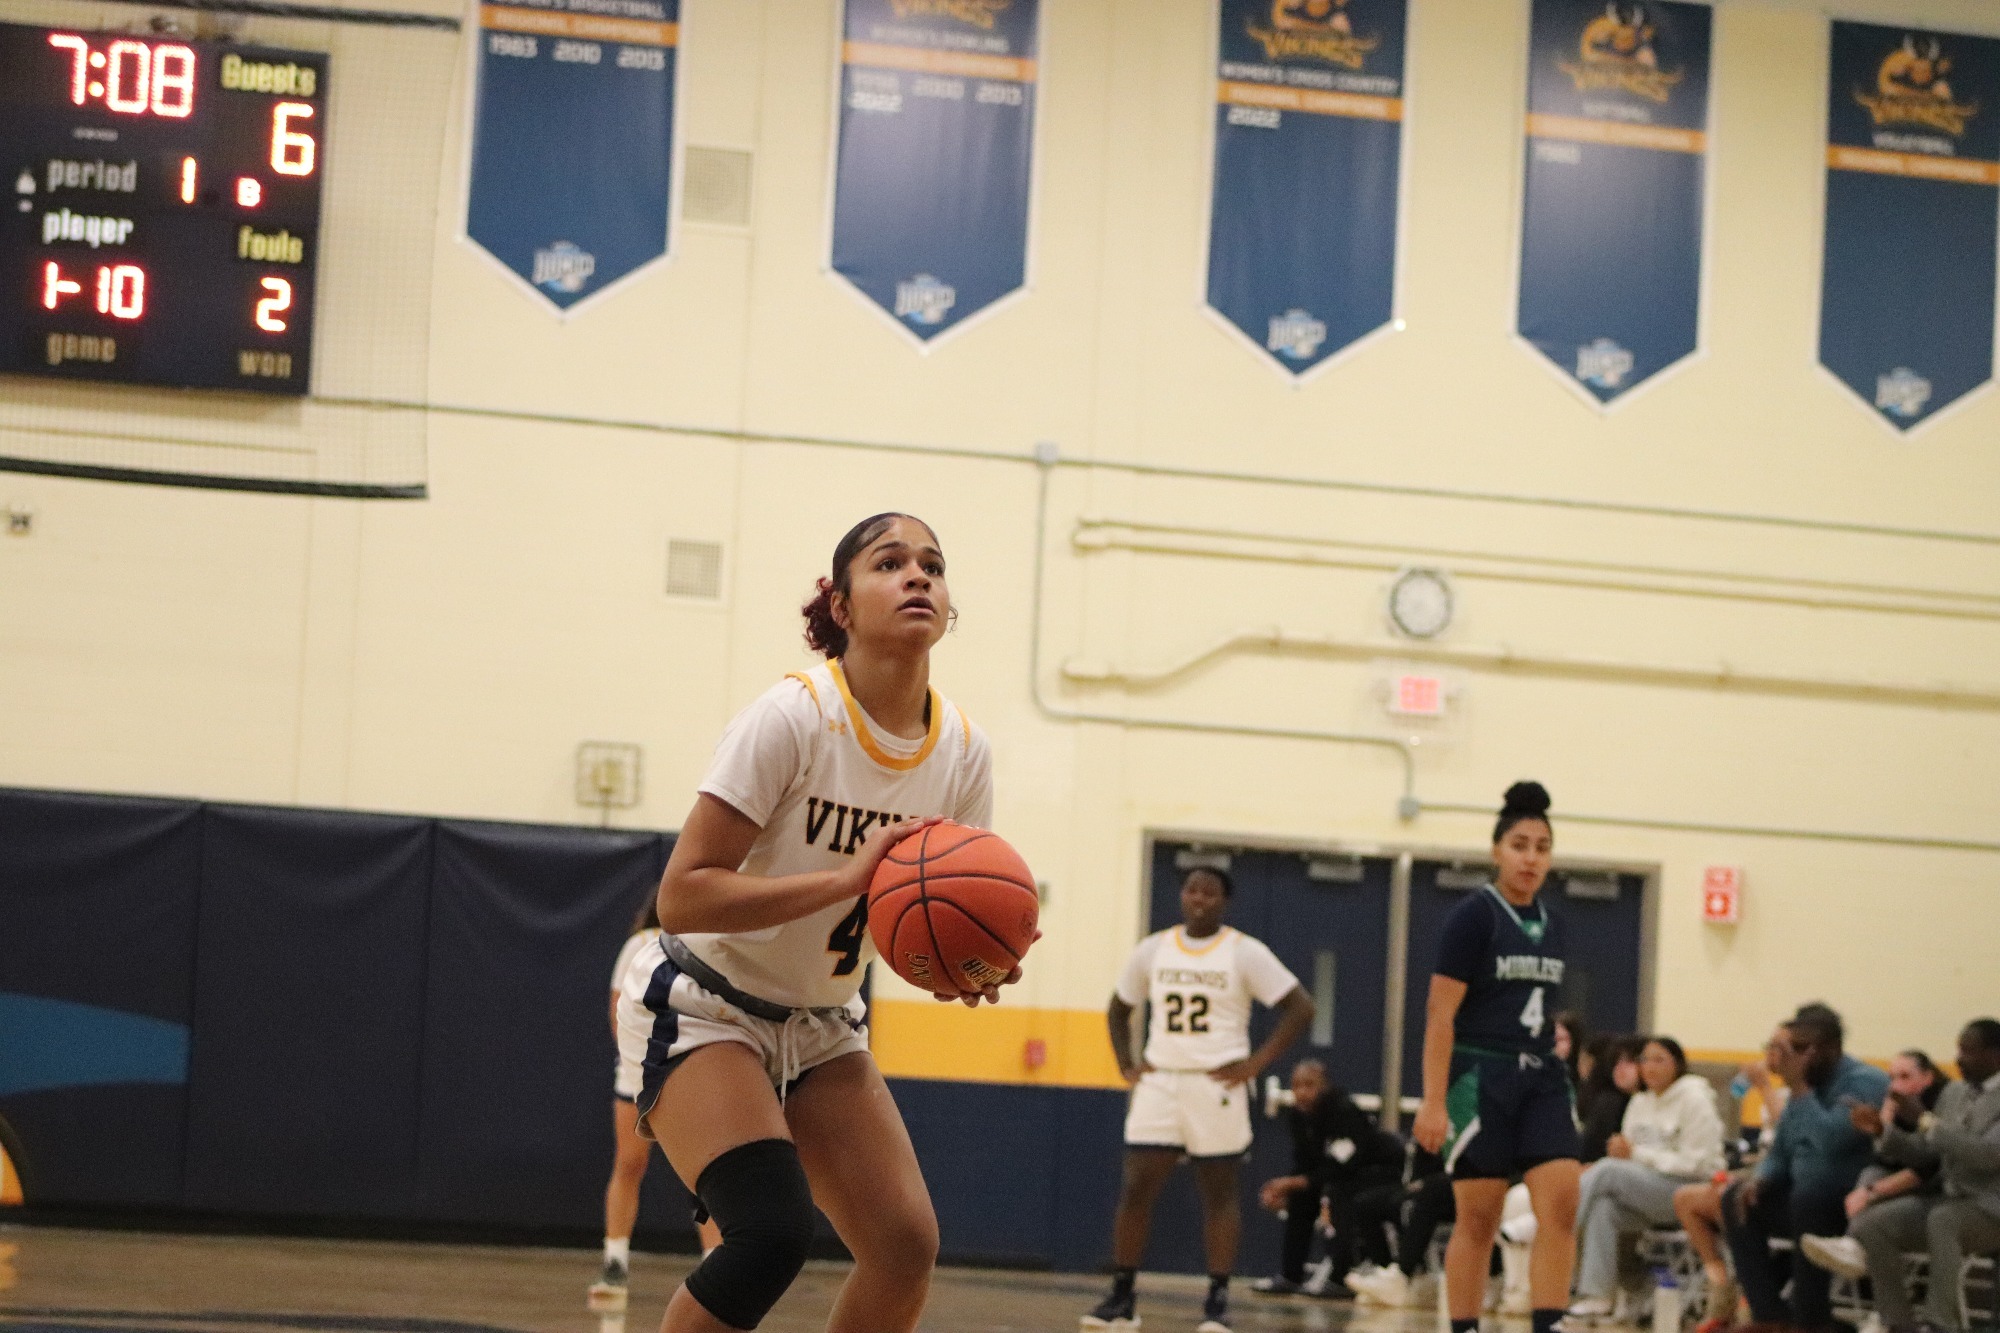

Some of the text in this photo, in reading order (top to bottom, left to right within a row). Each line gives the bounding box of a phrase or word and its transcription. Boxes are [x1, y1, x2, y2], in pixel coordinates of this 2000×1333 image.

[49, 33, 196, 118] 7:08
[221, 53, 316, 97] Guests
[270, 101, 315, 176] 6
[47, 159, 137, 193] period
[181, 156, 197, 205] 1
[43, 207, 134, 249] player
[238, 226, 303, 264] fouls
[256, 276, 291, 332] 2
[47, 332, 117, 366] game
[239, 351, 292, 379] won
[806, 797, 919, 855] VIK
[1165, 992, 1210, 1034] 22
[1519, 986, 1545, 1039] 4
